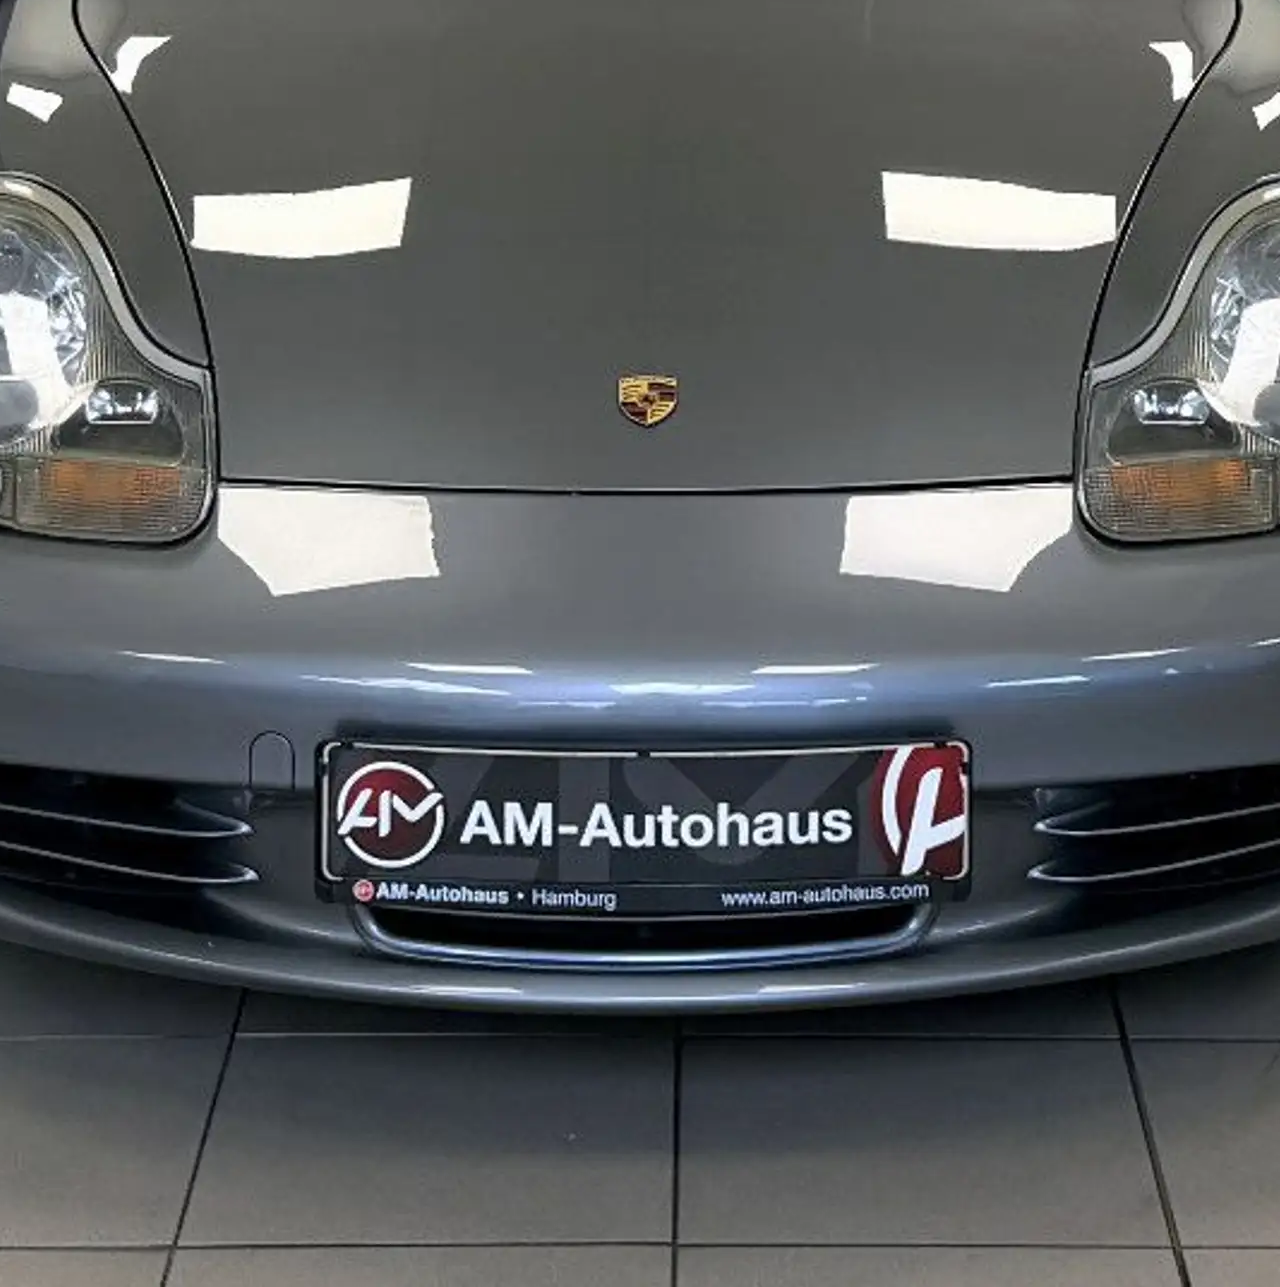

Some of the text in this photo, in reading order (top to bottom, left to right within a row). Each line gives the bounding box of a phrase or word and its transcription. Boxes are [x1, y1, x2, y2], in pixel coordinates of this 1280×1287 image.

[459, 800, 854, 849] AM-Autohaus
[375, 881, 510, 905] AM-Autohaus
[531, 887, 618, 911] Hamburg
[721, 883, 930, 907] www.am-autohaus.com
